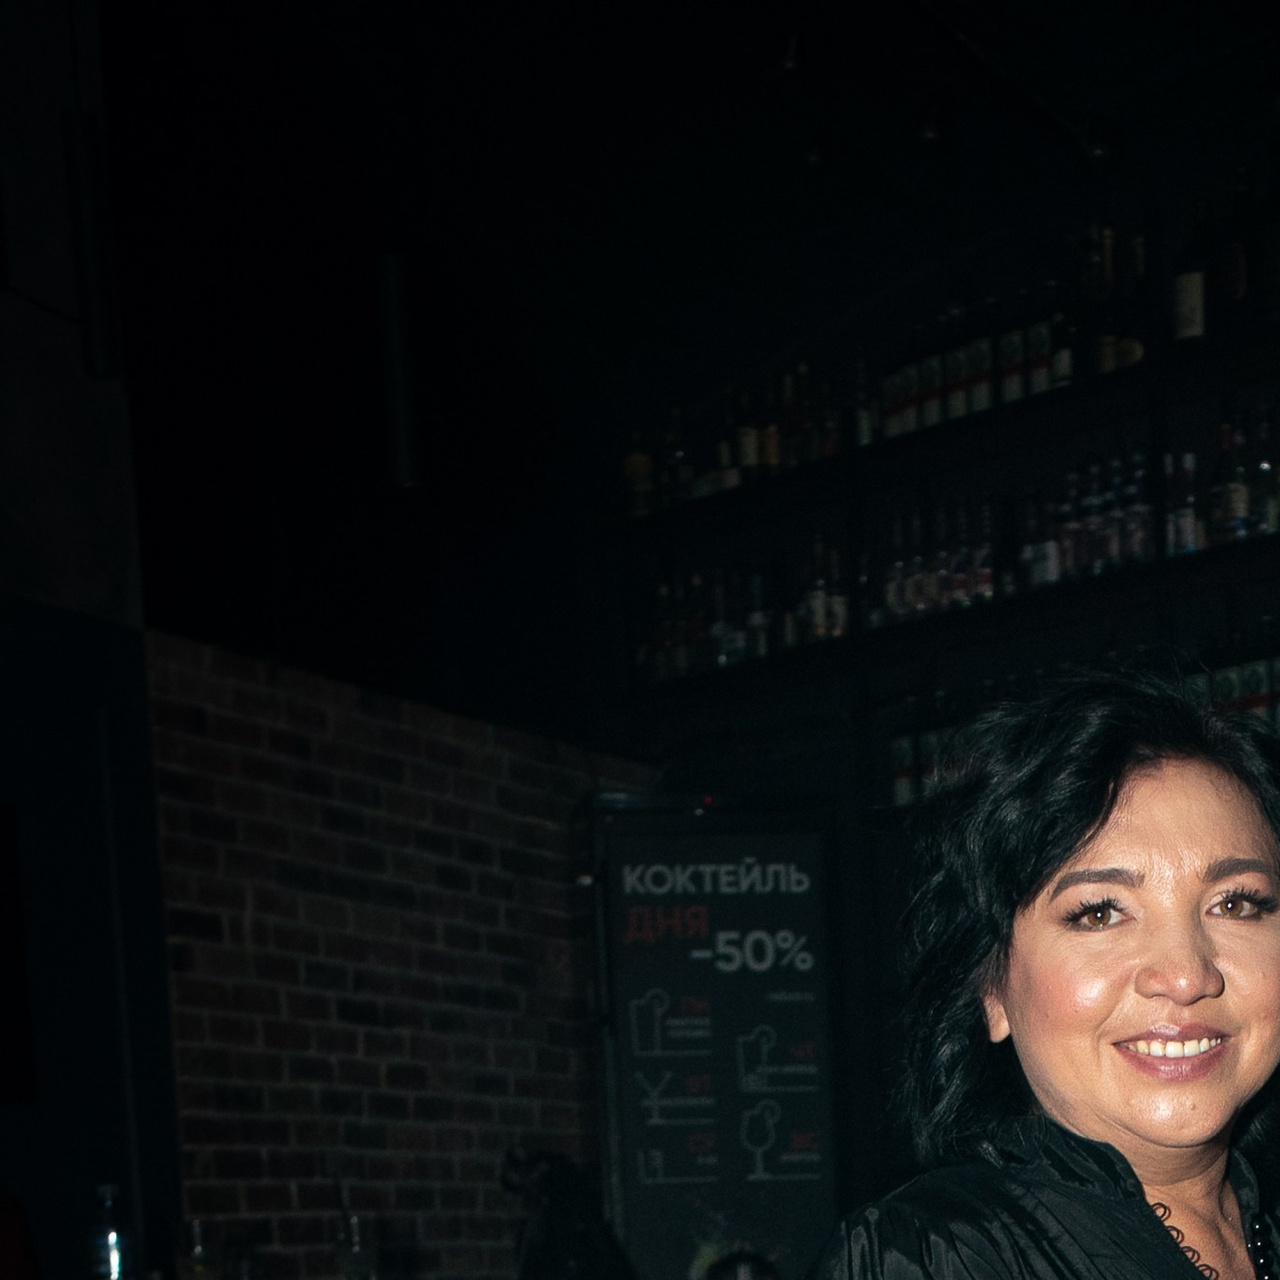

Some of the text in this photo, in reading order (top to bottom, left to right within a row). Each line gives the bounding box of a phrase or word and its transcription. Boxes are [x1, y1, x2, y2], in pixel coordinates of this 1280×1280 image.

[622, 858, 811, 895] КОКТЕЙЛЬ
[623, 905, 709, 944] ДНЯ
[690, 929, 815, 973] -50%
